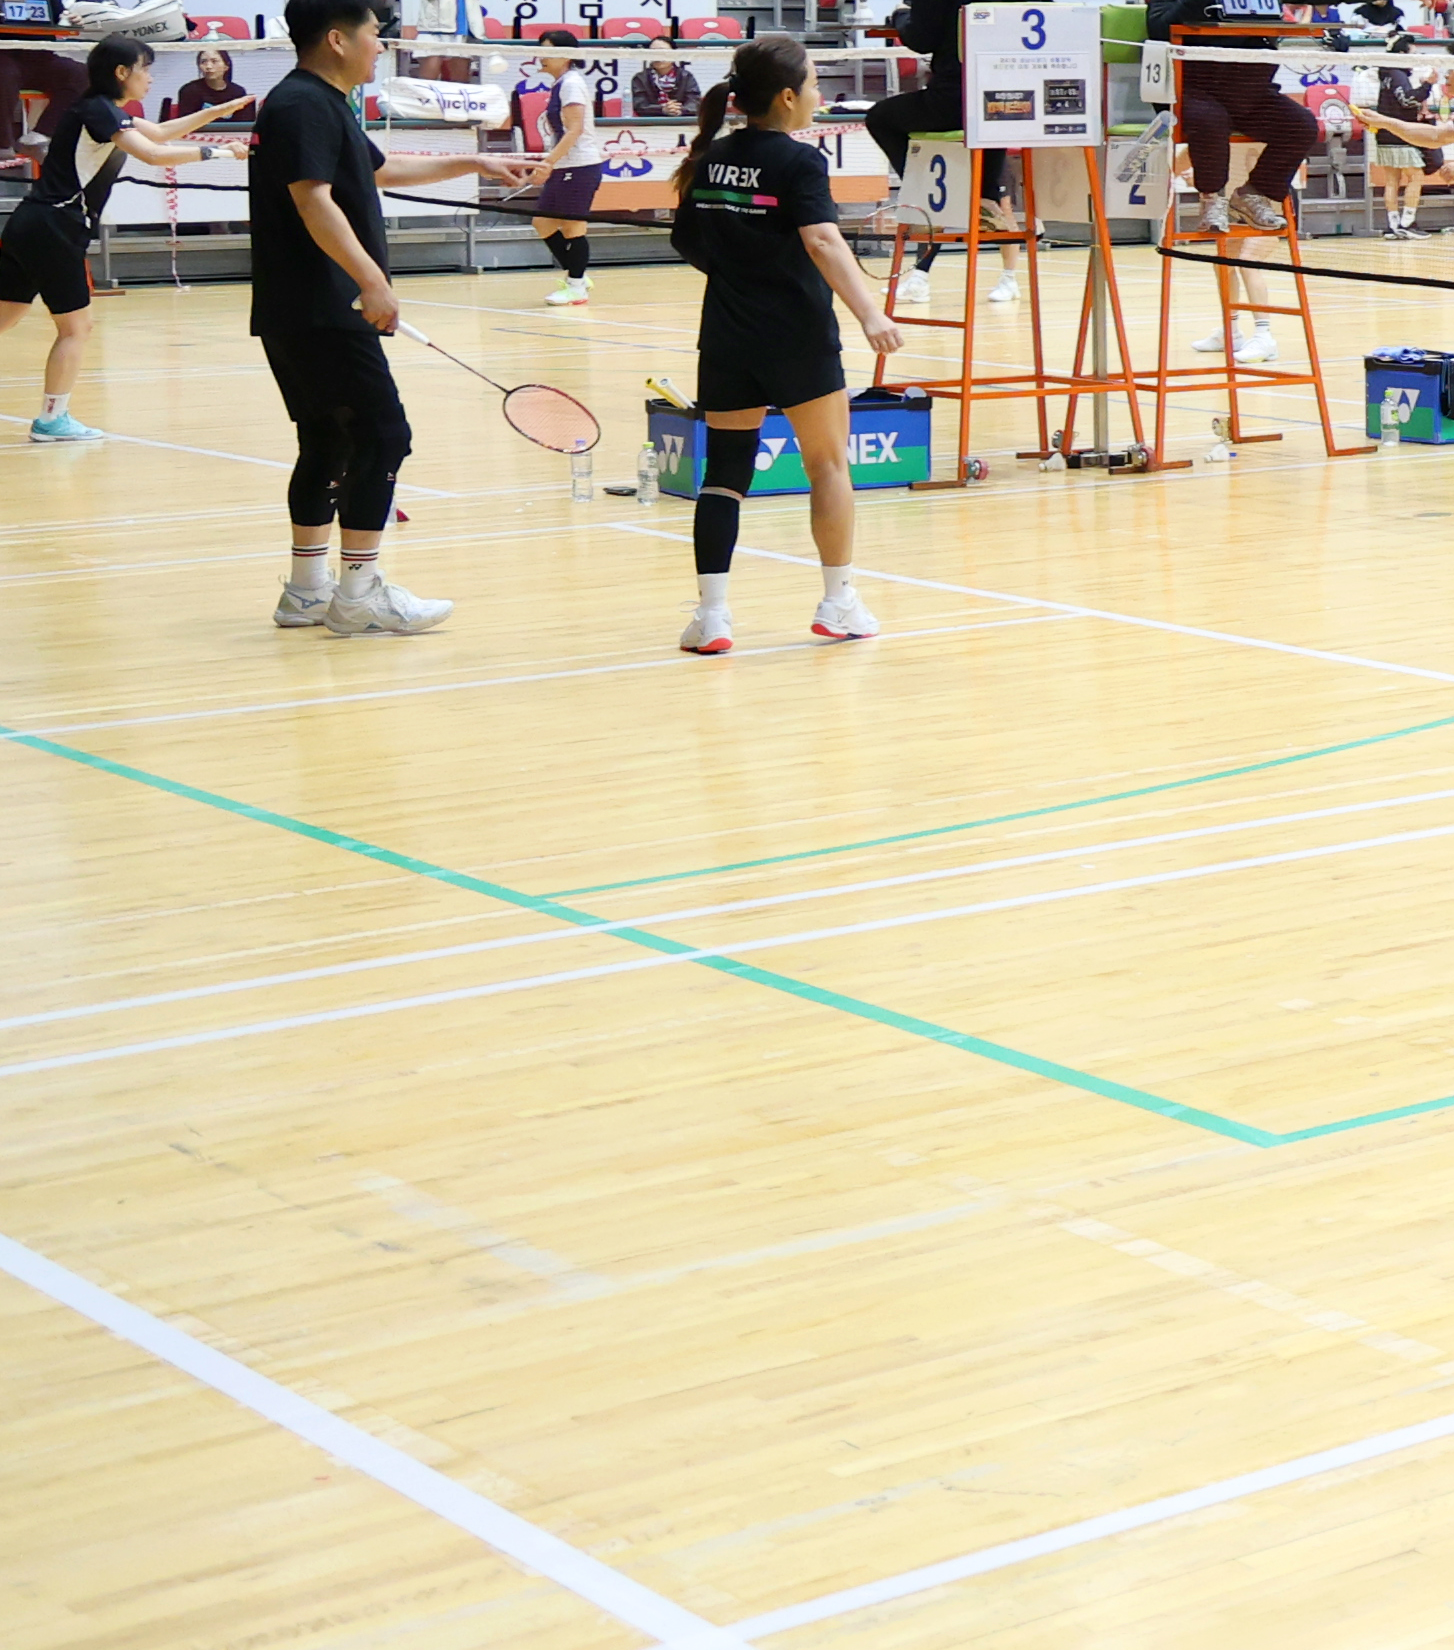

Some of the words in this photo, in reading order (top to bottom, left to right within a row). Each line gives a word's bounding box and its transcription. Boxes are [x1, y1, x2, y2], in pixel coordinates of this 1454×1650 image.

[30, 5, 46, 19] 23
[1021, 8, 1046, 50] 3
[1145, 63, 1161, 84] 13
[927, 153, 947, 213] 3
